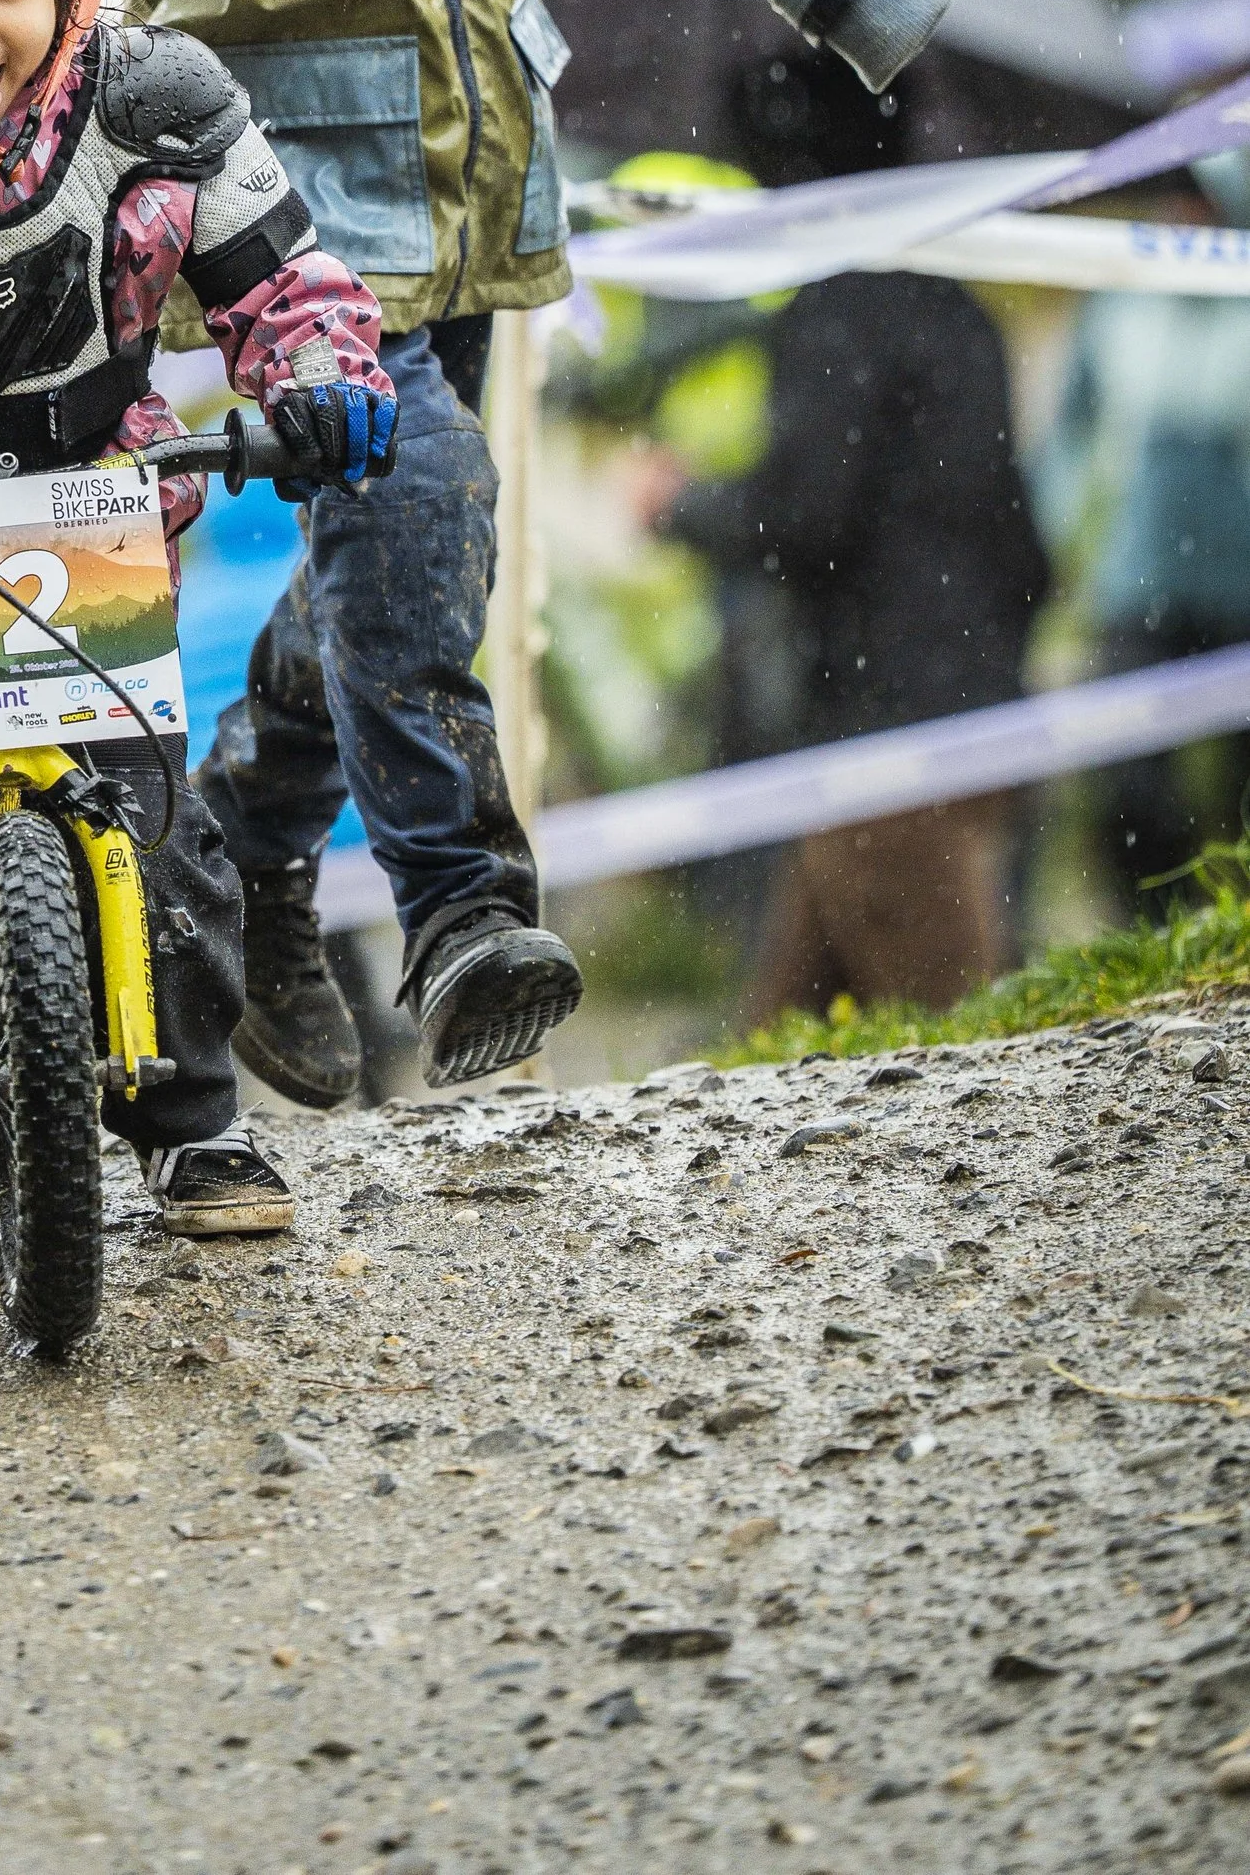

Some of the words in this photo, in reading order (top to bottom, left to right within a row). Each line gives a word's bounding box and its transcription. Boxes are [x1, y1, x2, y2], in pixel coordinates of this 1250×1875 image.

[51, 478, 114, 500] SWISS
[53, 495, 150, 520] BIKEPARK
[55, 518, 108, 529] OBERRIED
[25, 718, 48, 726] roots
[61, 711, 96, 724] SHORLEY
